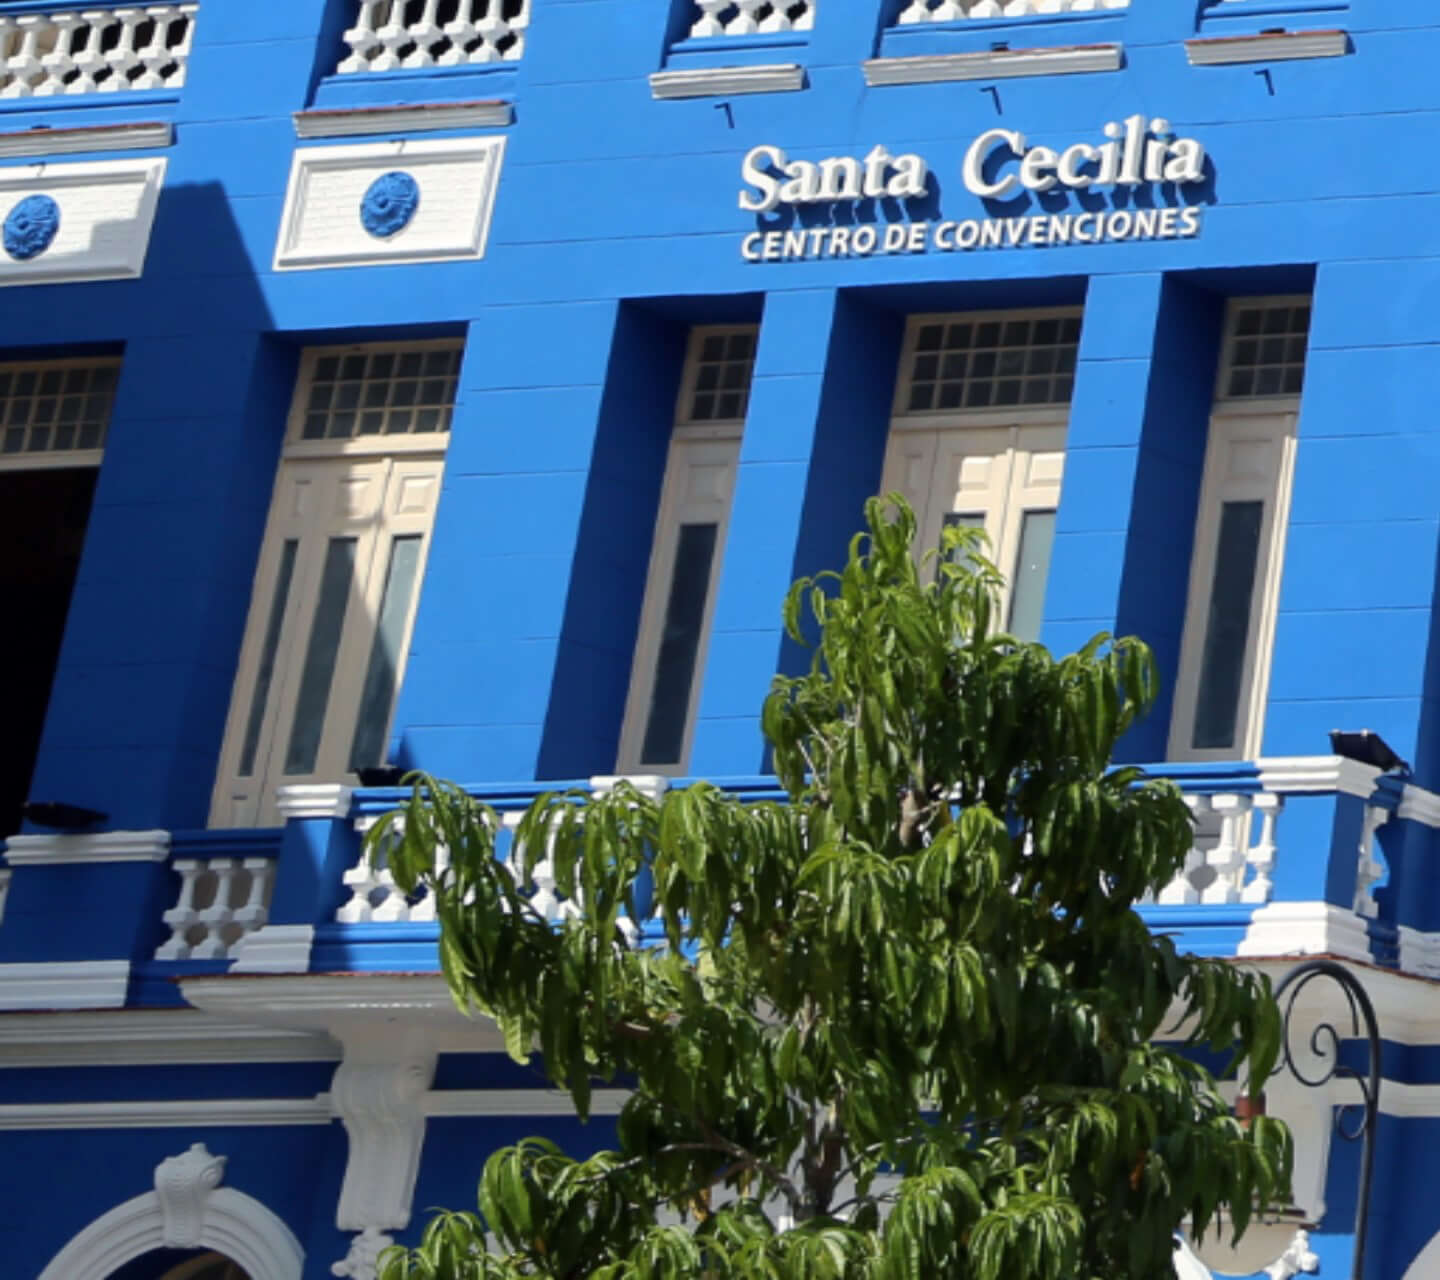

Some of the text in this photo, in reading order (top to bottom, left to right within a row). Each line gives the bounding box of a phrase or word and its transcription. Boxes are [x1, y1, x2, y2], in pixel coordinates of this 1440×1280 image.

[738, 114, 1206, 212] Santa Cecilia
[741, 208, 1200, 260] CENTRO DE CONVENCIONES
